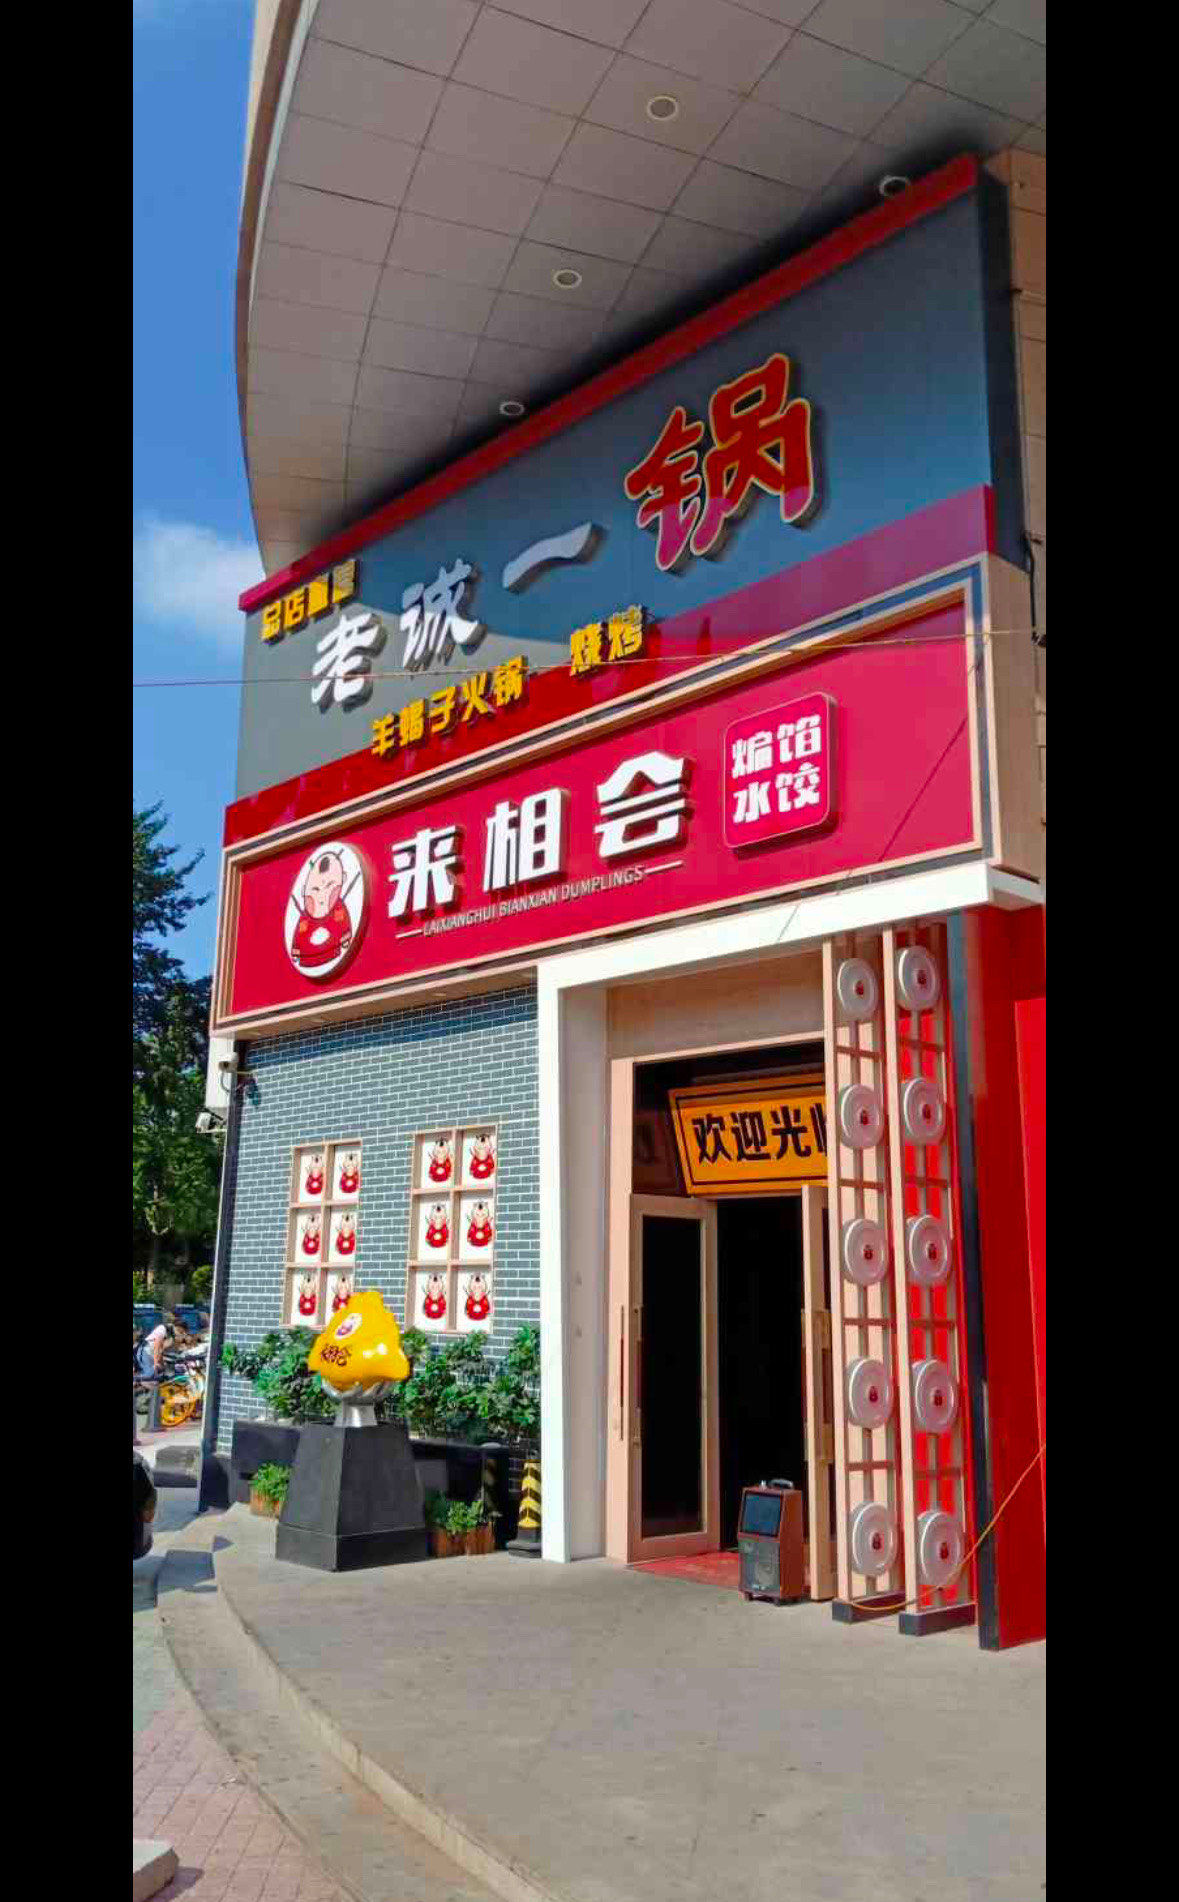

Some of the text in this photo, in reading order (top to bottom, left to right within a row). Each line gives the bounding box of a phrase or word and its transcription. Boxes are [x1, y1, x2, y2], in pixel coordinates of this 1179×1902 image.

[570, 604, 643, 677] 烧烤
[732, 761, 821, 824] 水饺
[387, 750, 686, 918] 来相会
[422, 864, 645, 937] LAIXIANGHUI BIANXIAN DUMPLINGS
